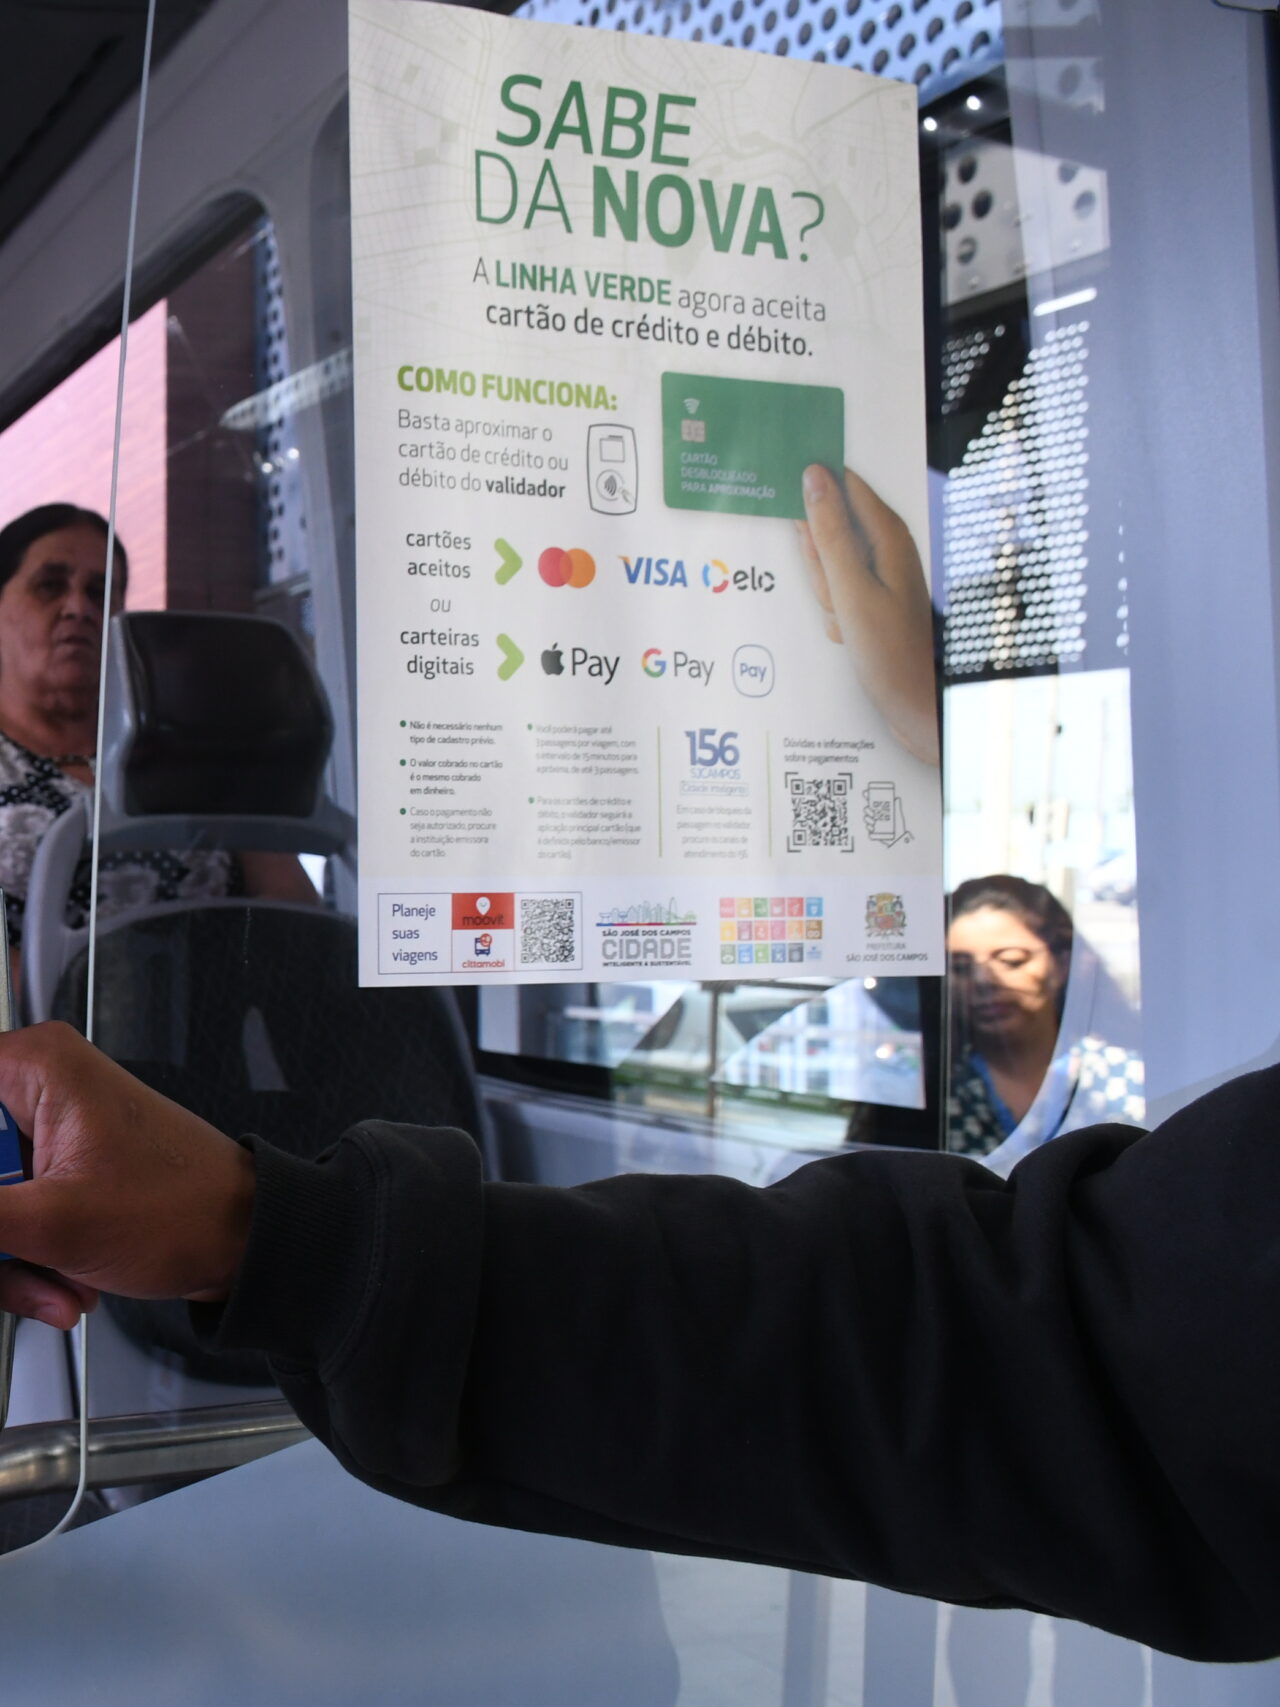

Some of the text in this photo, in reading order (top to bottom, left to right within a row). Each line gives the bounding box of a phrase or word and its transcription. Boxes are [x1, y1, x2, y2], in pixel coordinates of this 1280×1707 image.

[495, 73, 696, 167] SABE
[474, 149, 826, 263] DA NOVA?
[472, 256, 826, 322] A LINHA VERDE agora aceita
[486, 303, 813, 357] cartão de crédito e débito.
[397, 365, 618, 411] COMO FUNCIONA:
[398, 408, 553, 442] Basta aproximar o
[398, 441, 569, 471] cartão de crédito ou
[680, 452, 718, 466] CARTÃO
[398, 467, 566, 498] débito do validador
[680, 481, 707, 492] PARA
[406, 530, 472, 551] cartões
[407, 559, 471, 579] aceitos
[617, 555, 775, 593] VISA elo
[430, 598, 451, 613] ou
[399, 628, 479, 647] carteiras
[406, 654, 474, 681] digitais
[571, 648, 621, 686] Pay
[673, 651, 716, 687] Pay
[739, 662, 767, 683] Pay
[410, 721, 425, 730] Não
[432, 722, 472, 731] necessário
[473, 722, 503, 731] nenhum
[410, 735, 425, 745] tipo
[426, 735, 436, 744] de
[437, 735, 469, 744] cadastro
[684, 728, 740, 767] 156
[784, 737, 815, 748] Dúvidas
[823, 738, 875, 752] informações
[410, 758, 417, 767] O
[418, 758, 437, 767] valor
[437, 758, 468, 768] cobrado
[479, 759, 503, 768] cartão
[784, 752, 859, 765] sobre pagamentos
[451, 772, 481, 782] cobrado
[410, 787, 422, 795] em
[410, 806, 429, 816] Caso
[435, 809, 478, 818] pagamento
[478, 807, 493, 816] não
[391, 903, 436, 921] Planeje
[461, 914, 504, 926] moovit
[391, 928, 420, 939] suas
[602, 929, 618, 937] SÃO
[620, 929, 639, 937] JOSÉ
[391, 949, 438, 965] viagens
[602, 938, 692, 960] CIDADE
[846, 952, 928, 962] SÃO JOSÉ DOS CAMPOS
[461, 958, 506, 969] cittamobi
